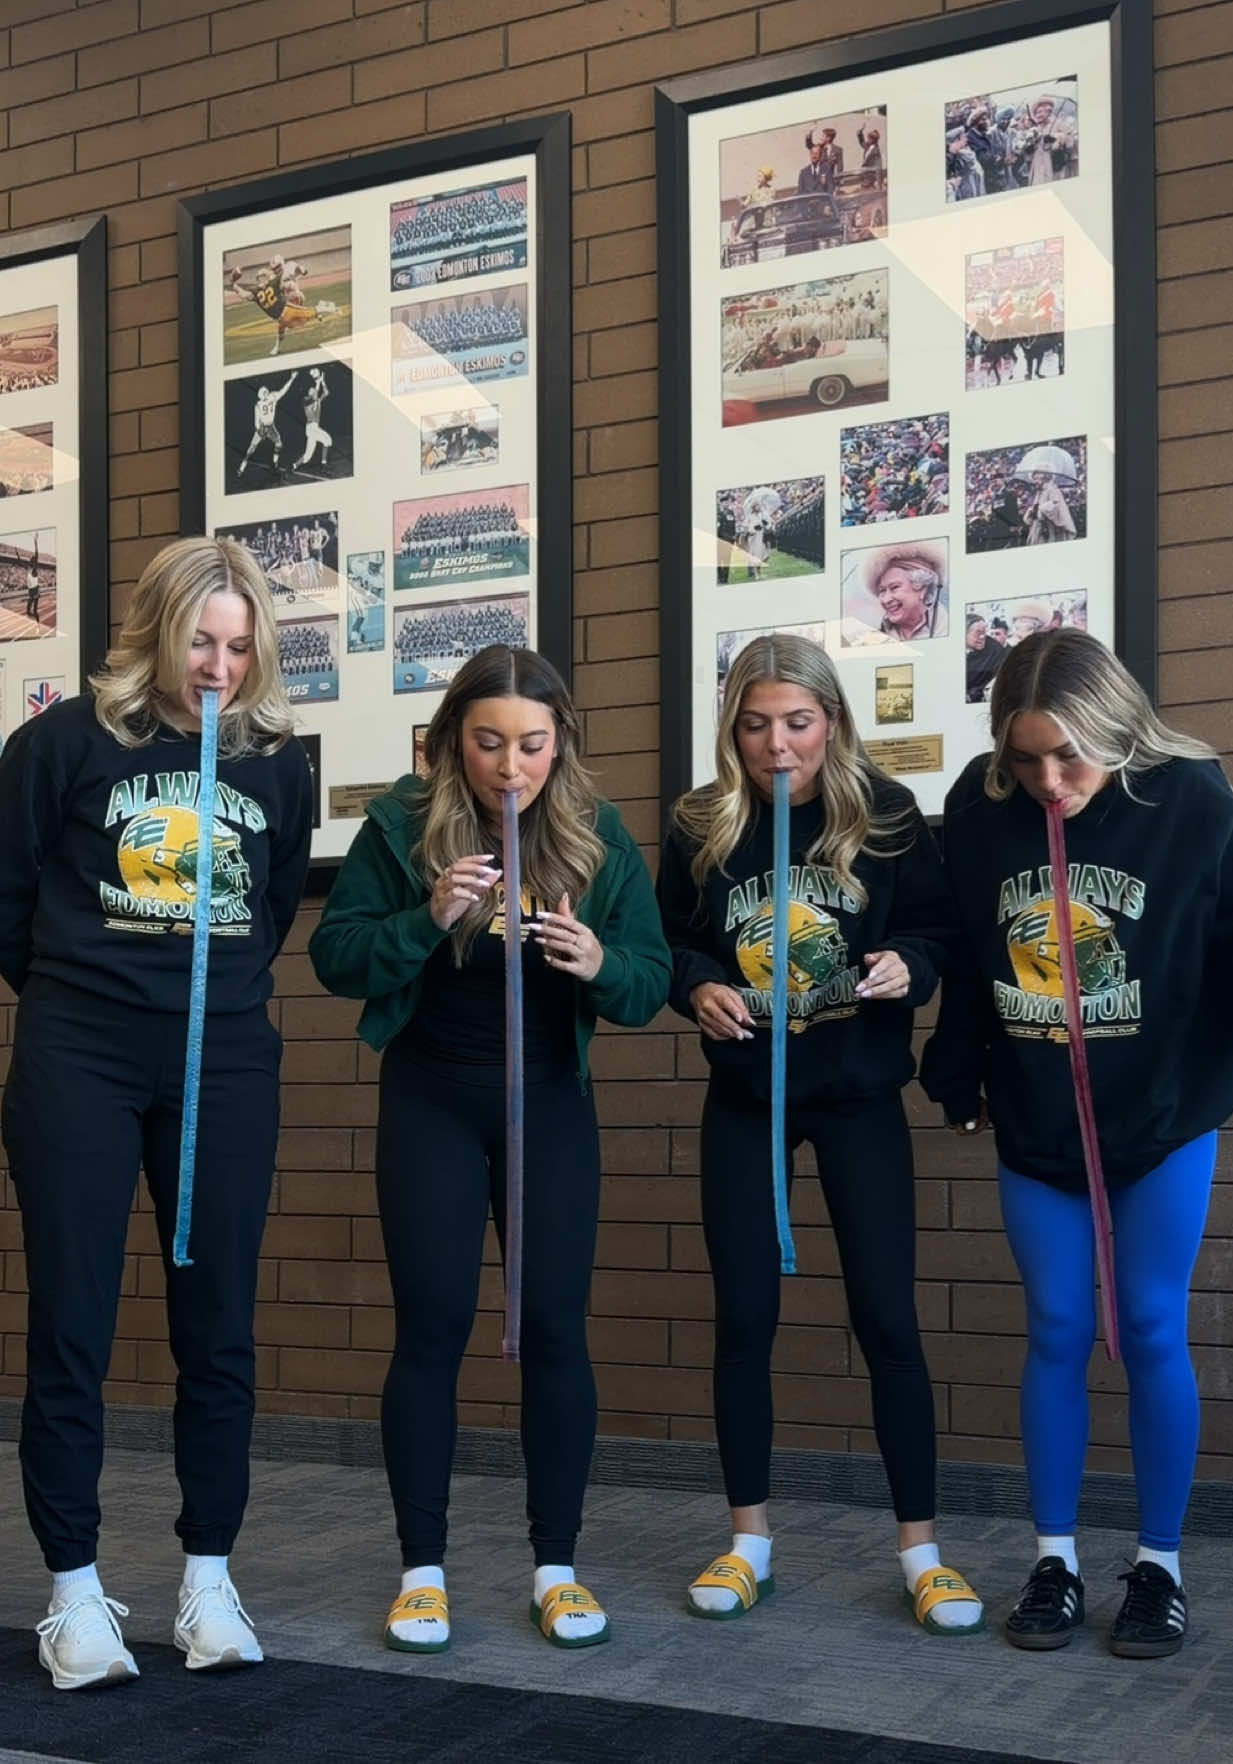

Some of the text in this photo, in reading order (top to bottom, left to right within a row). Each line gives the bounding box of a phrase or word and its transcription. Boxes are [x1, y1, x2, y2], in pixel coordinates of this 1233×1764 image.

[481, 250, 514, 270] ESKIMOS
[464, 355, 505, 373] ESKIMOS
[433, 553, 488, 568] ESKIMOS
[100, 880, 252, 924] EDMOON
[998, 864, 1146, 921] ALWAYS
[731, 965, 860, 1017] DONTON
[994, 979, 1142, 1024] EDMOTON
